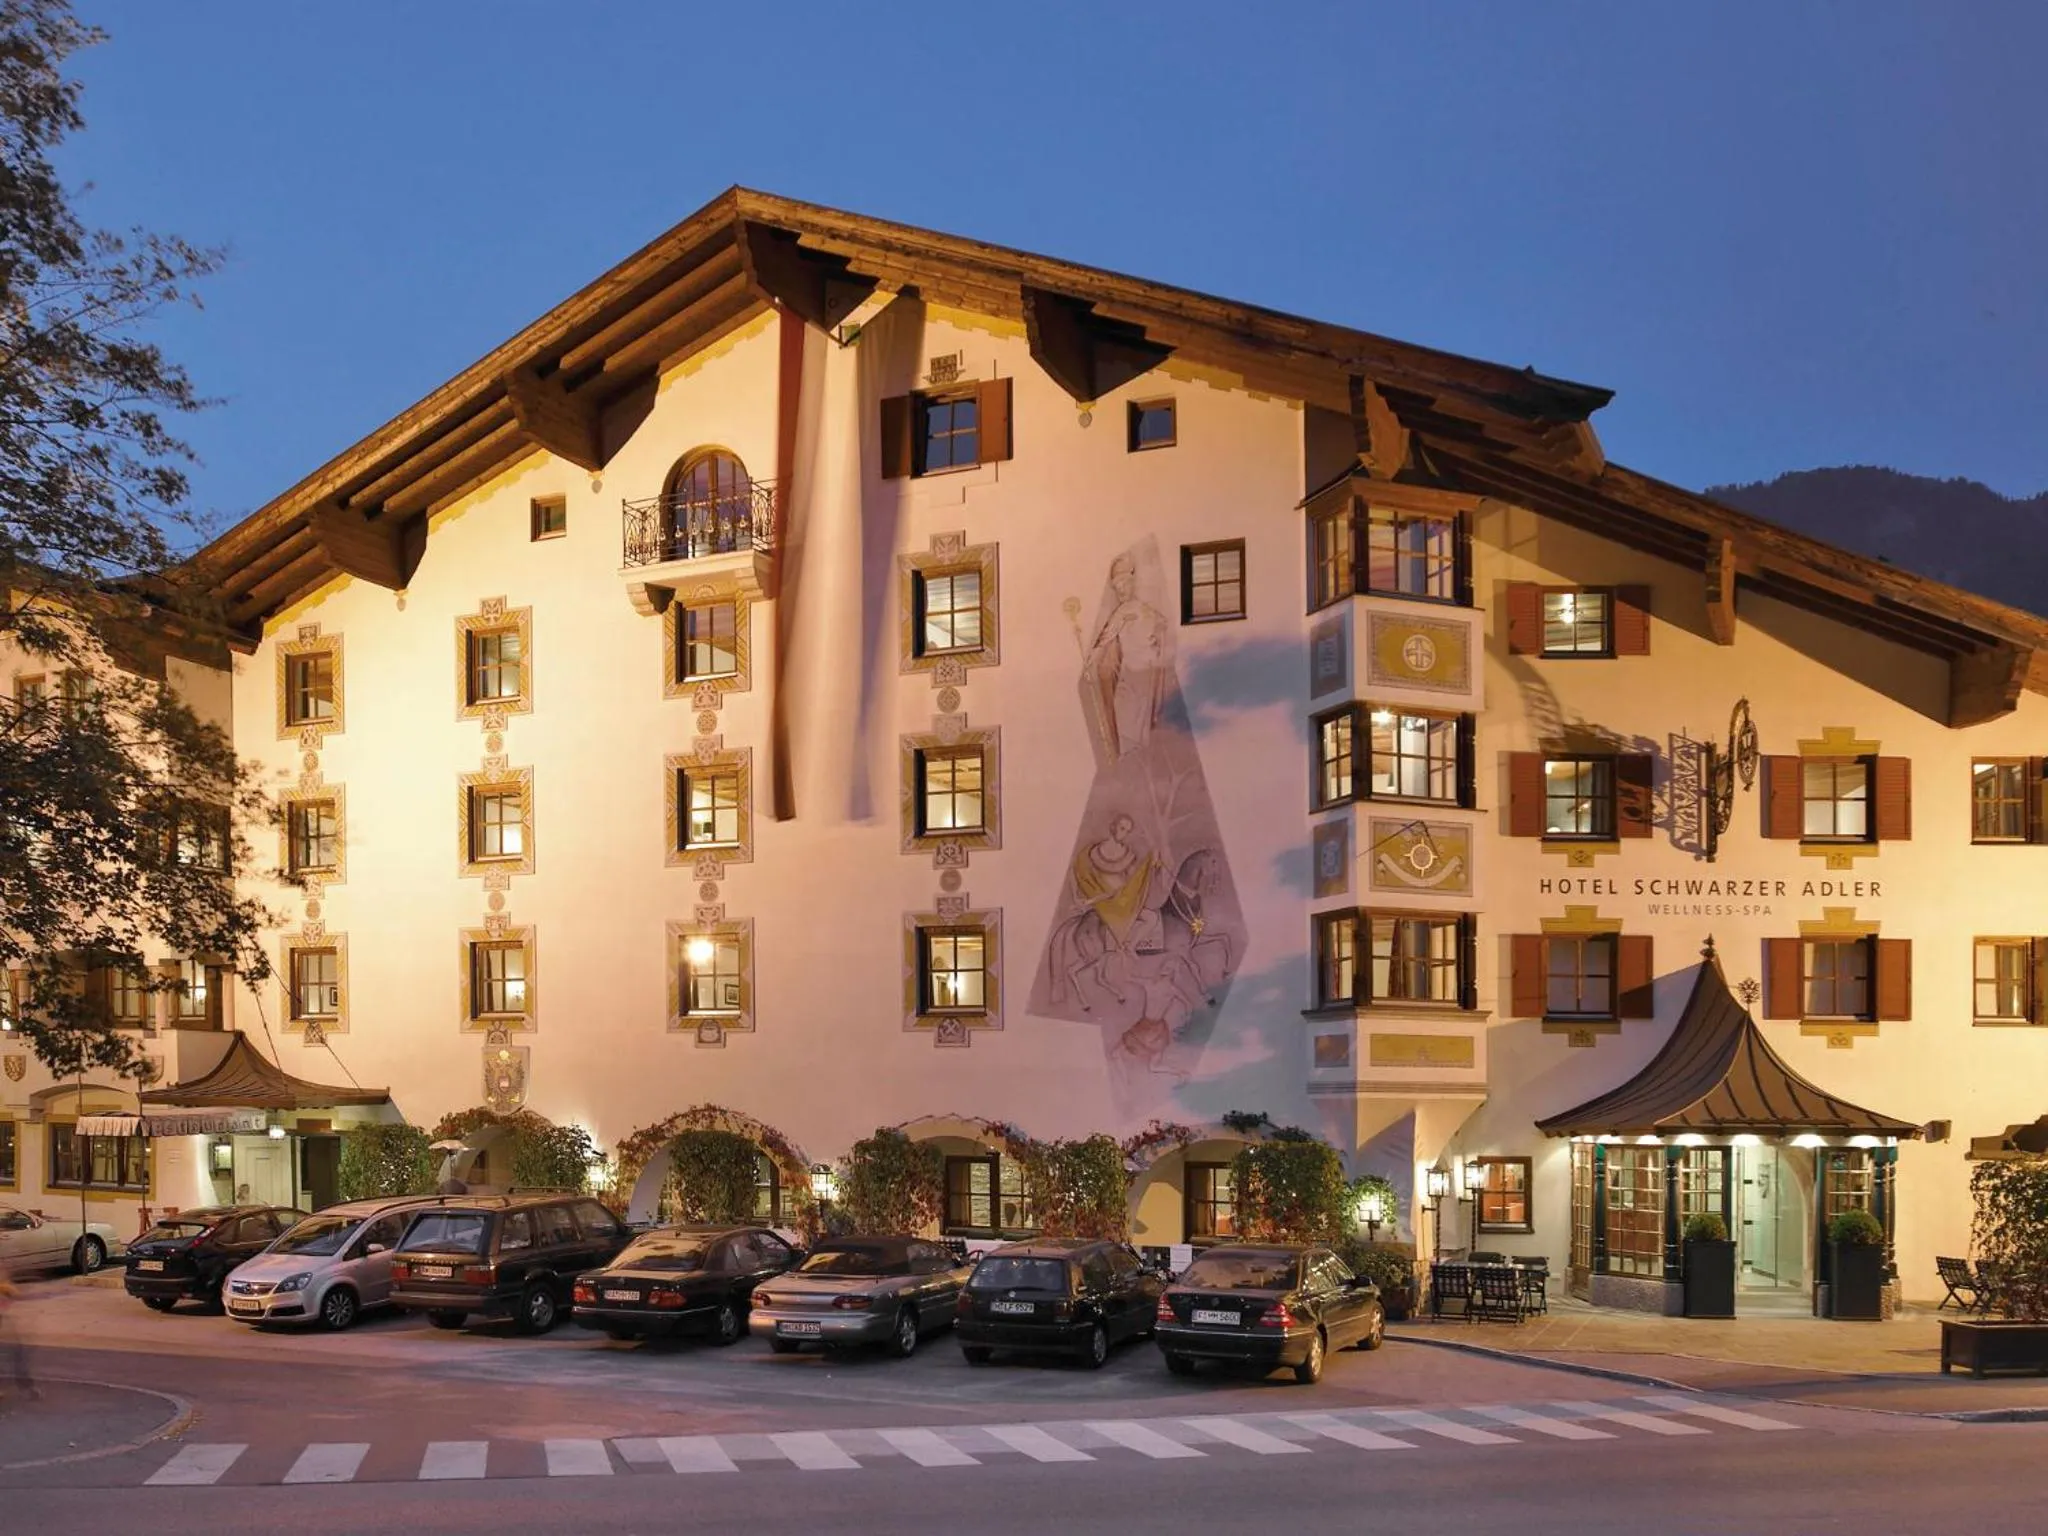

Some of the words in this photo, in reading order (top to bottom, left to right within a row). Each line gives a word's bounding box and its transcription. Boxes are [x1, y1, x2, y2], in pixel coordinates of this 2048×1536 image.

[1540, 878, 1618, 895] HOTEL
[1634, 879, 1786, 897] SCHWARZER
[1802, 881, 1882, 897] ADLER
[1648, 903, 1772, 916] WELLNESS-SPA
